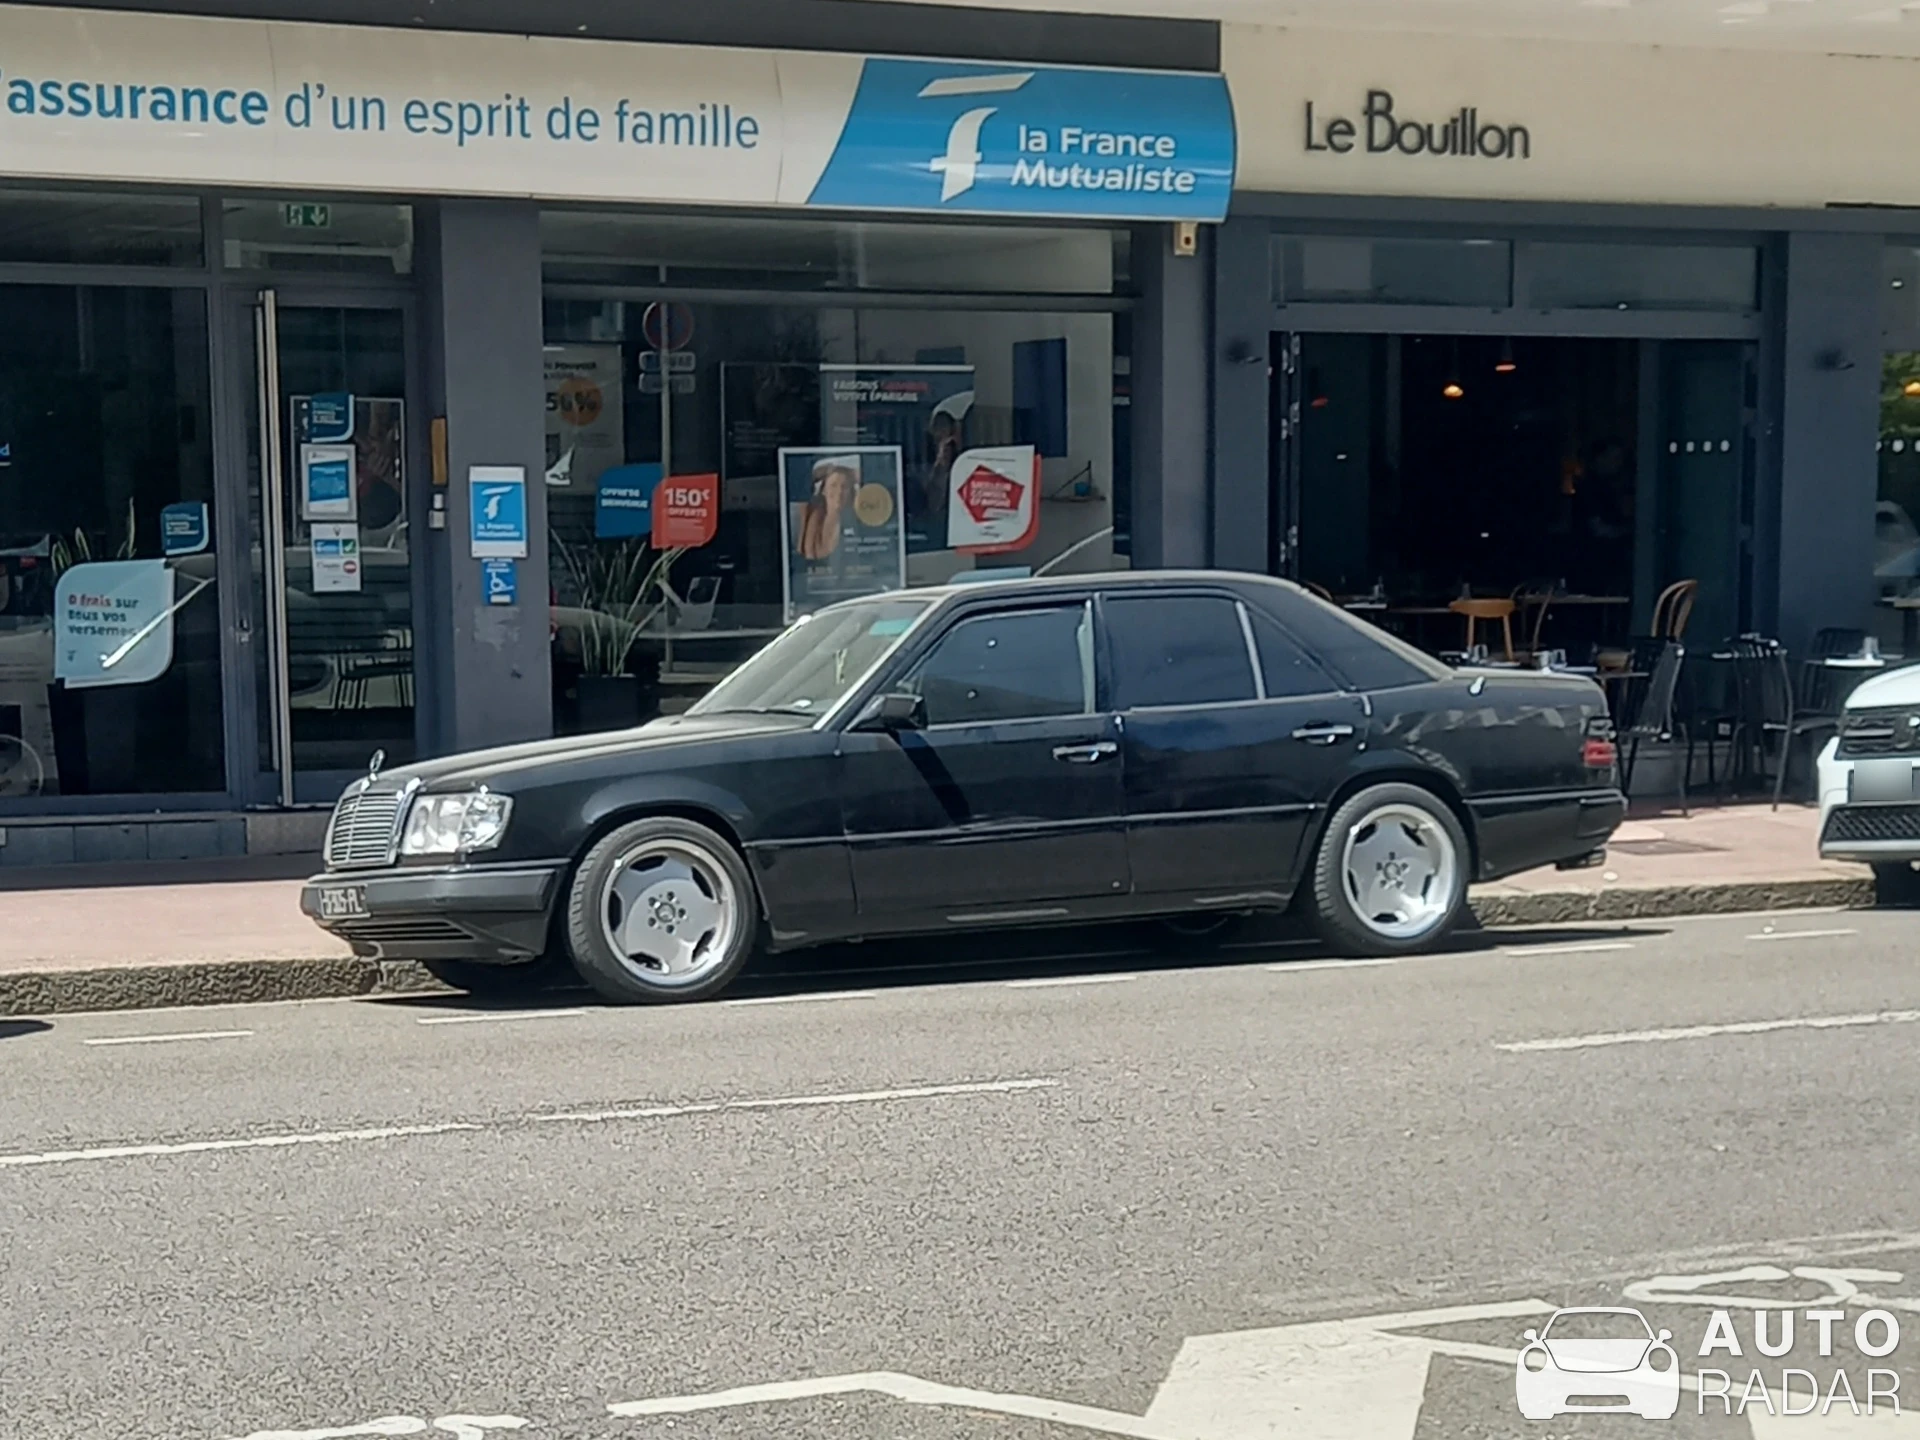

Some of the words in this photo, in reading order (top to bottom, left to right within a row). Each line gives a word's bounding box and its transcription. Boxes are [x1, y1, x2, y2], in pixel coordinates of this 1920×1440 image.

[404, 94, 531, 147] esprit
[547, 96, 600, 141] de
[614, 99, 759, 150] famille
[1304, 101, 1356, 155] Le
[1363, 90, 1530, 159] Bouillon
[1019, 125, 1047, 152] la
[1061, 127, 1175, 158] France
[1011, 160, 1196, 194] Mutualiste
[80, 593, 111, 608] frais
[116, 598, 139, 609] sur
[102, 612, 127, 622] vos
